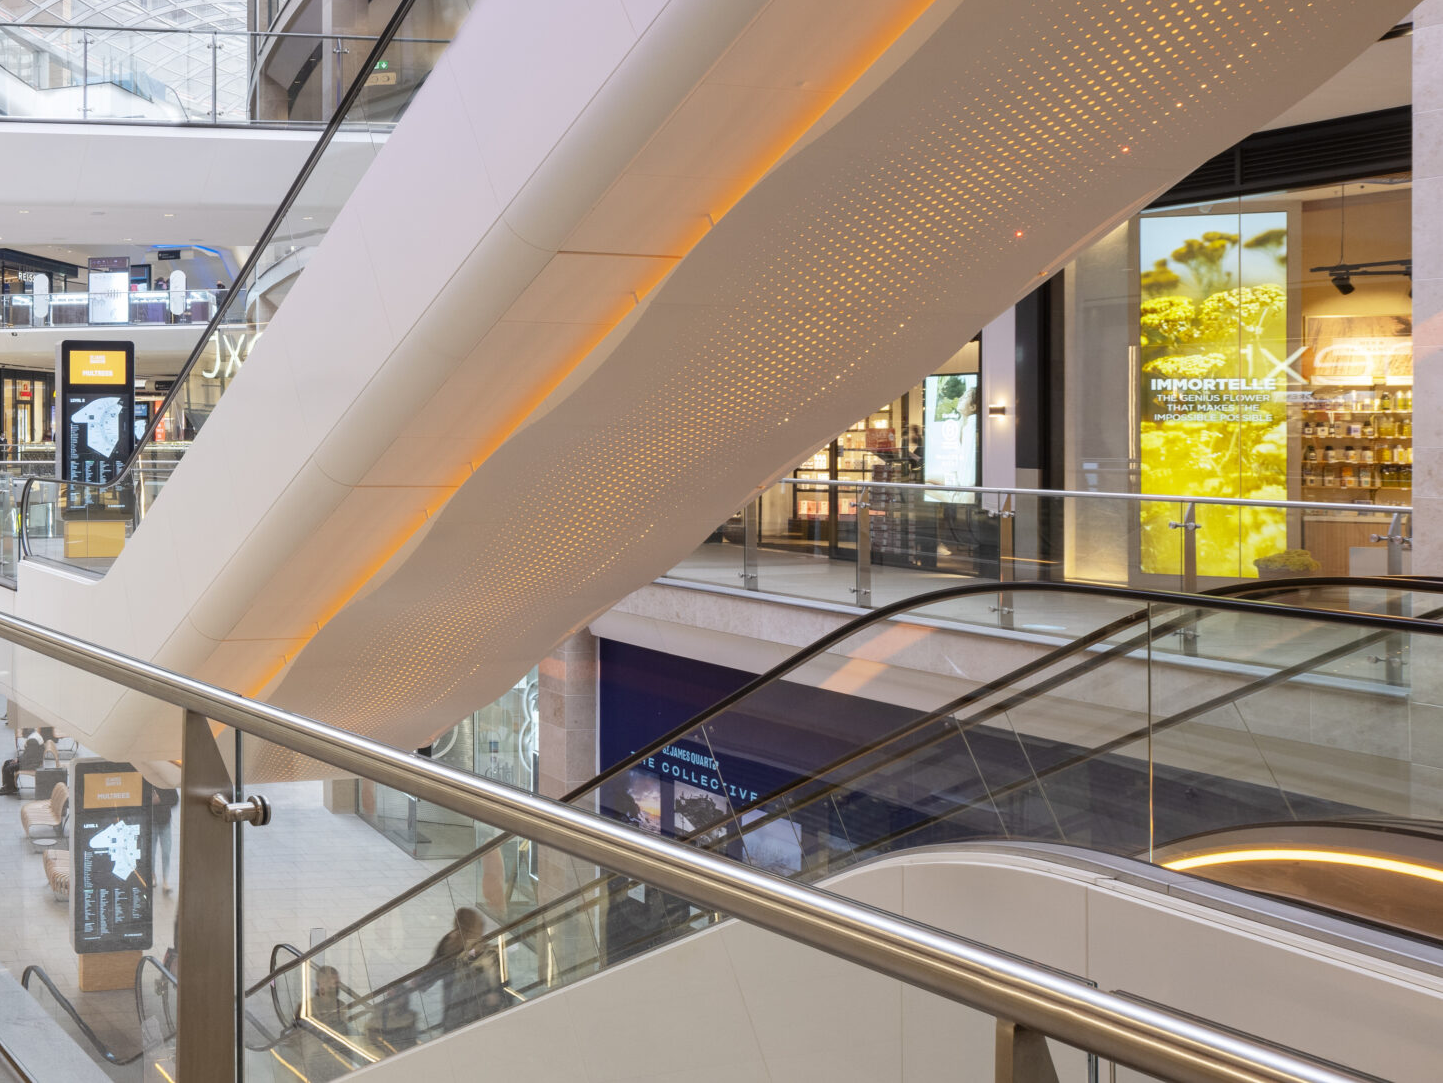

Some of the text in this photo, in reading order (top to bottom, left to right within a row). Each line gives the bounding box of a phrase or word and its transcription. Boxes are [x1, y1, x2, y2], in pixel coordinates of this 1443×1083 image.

[1150, 378, 1277, 391] IMMORTELLE
[1157, 394, 1270, 402] THE GENIUS FLOWER
[1197, 404, 1235, 412] MAKES
[1154, 414, 1217, 422] IMPOSSIBLE
[670, 746, 691, 762] JAMES
[661, 761, 758, 802] COLLECIVE
